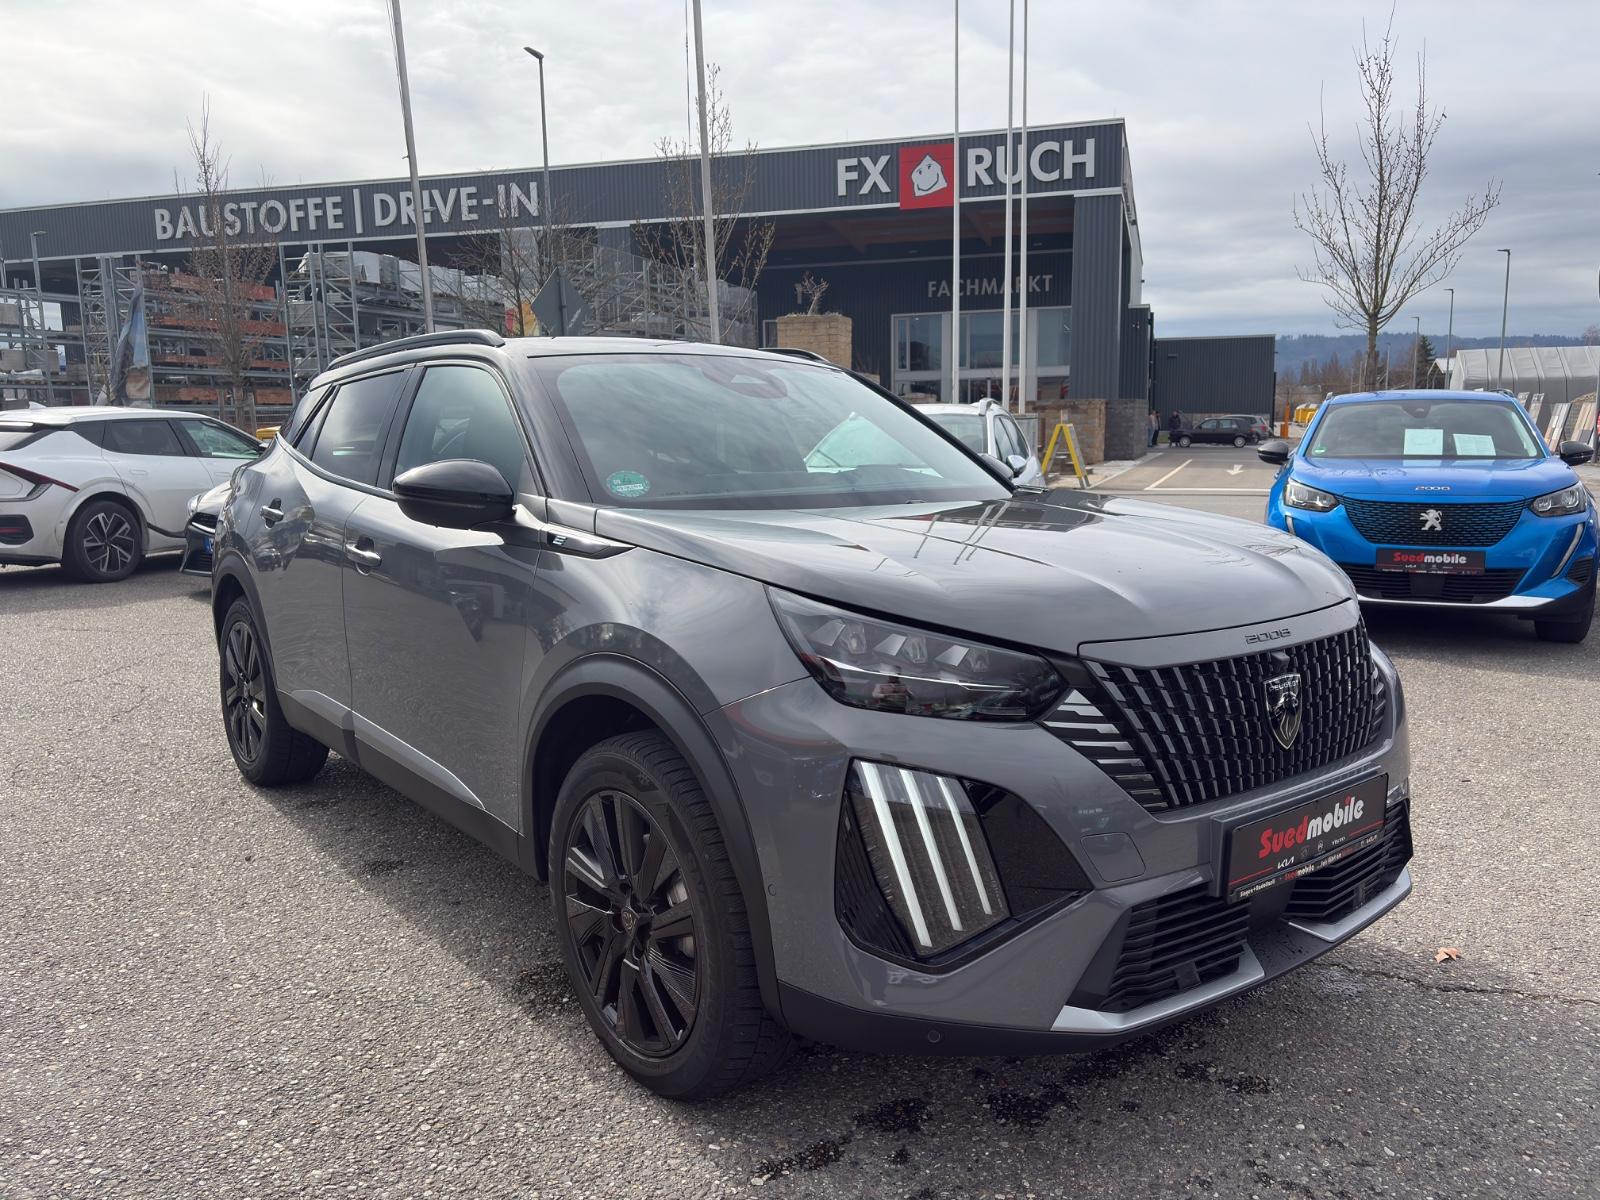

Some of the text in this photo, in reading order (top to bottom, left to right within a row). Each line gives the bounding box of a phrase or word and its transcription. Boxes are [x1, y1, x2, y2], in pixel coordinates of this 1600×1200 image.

[836, 138, 1096, 197] FX RUCH
[154, 196, 345, 241] BAUSTOFFE
[373, 181, 540, 228] DRIVE-IN
[1393, 552, 1467, 565] Suedmobile
[1244, 628, 1292, 645] 2008
[1258, 795, 1365, 859] Suedmobile
